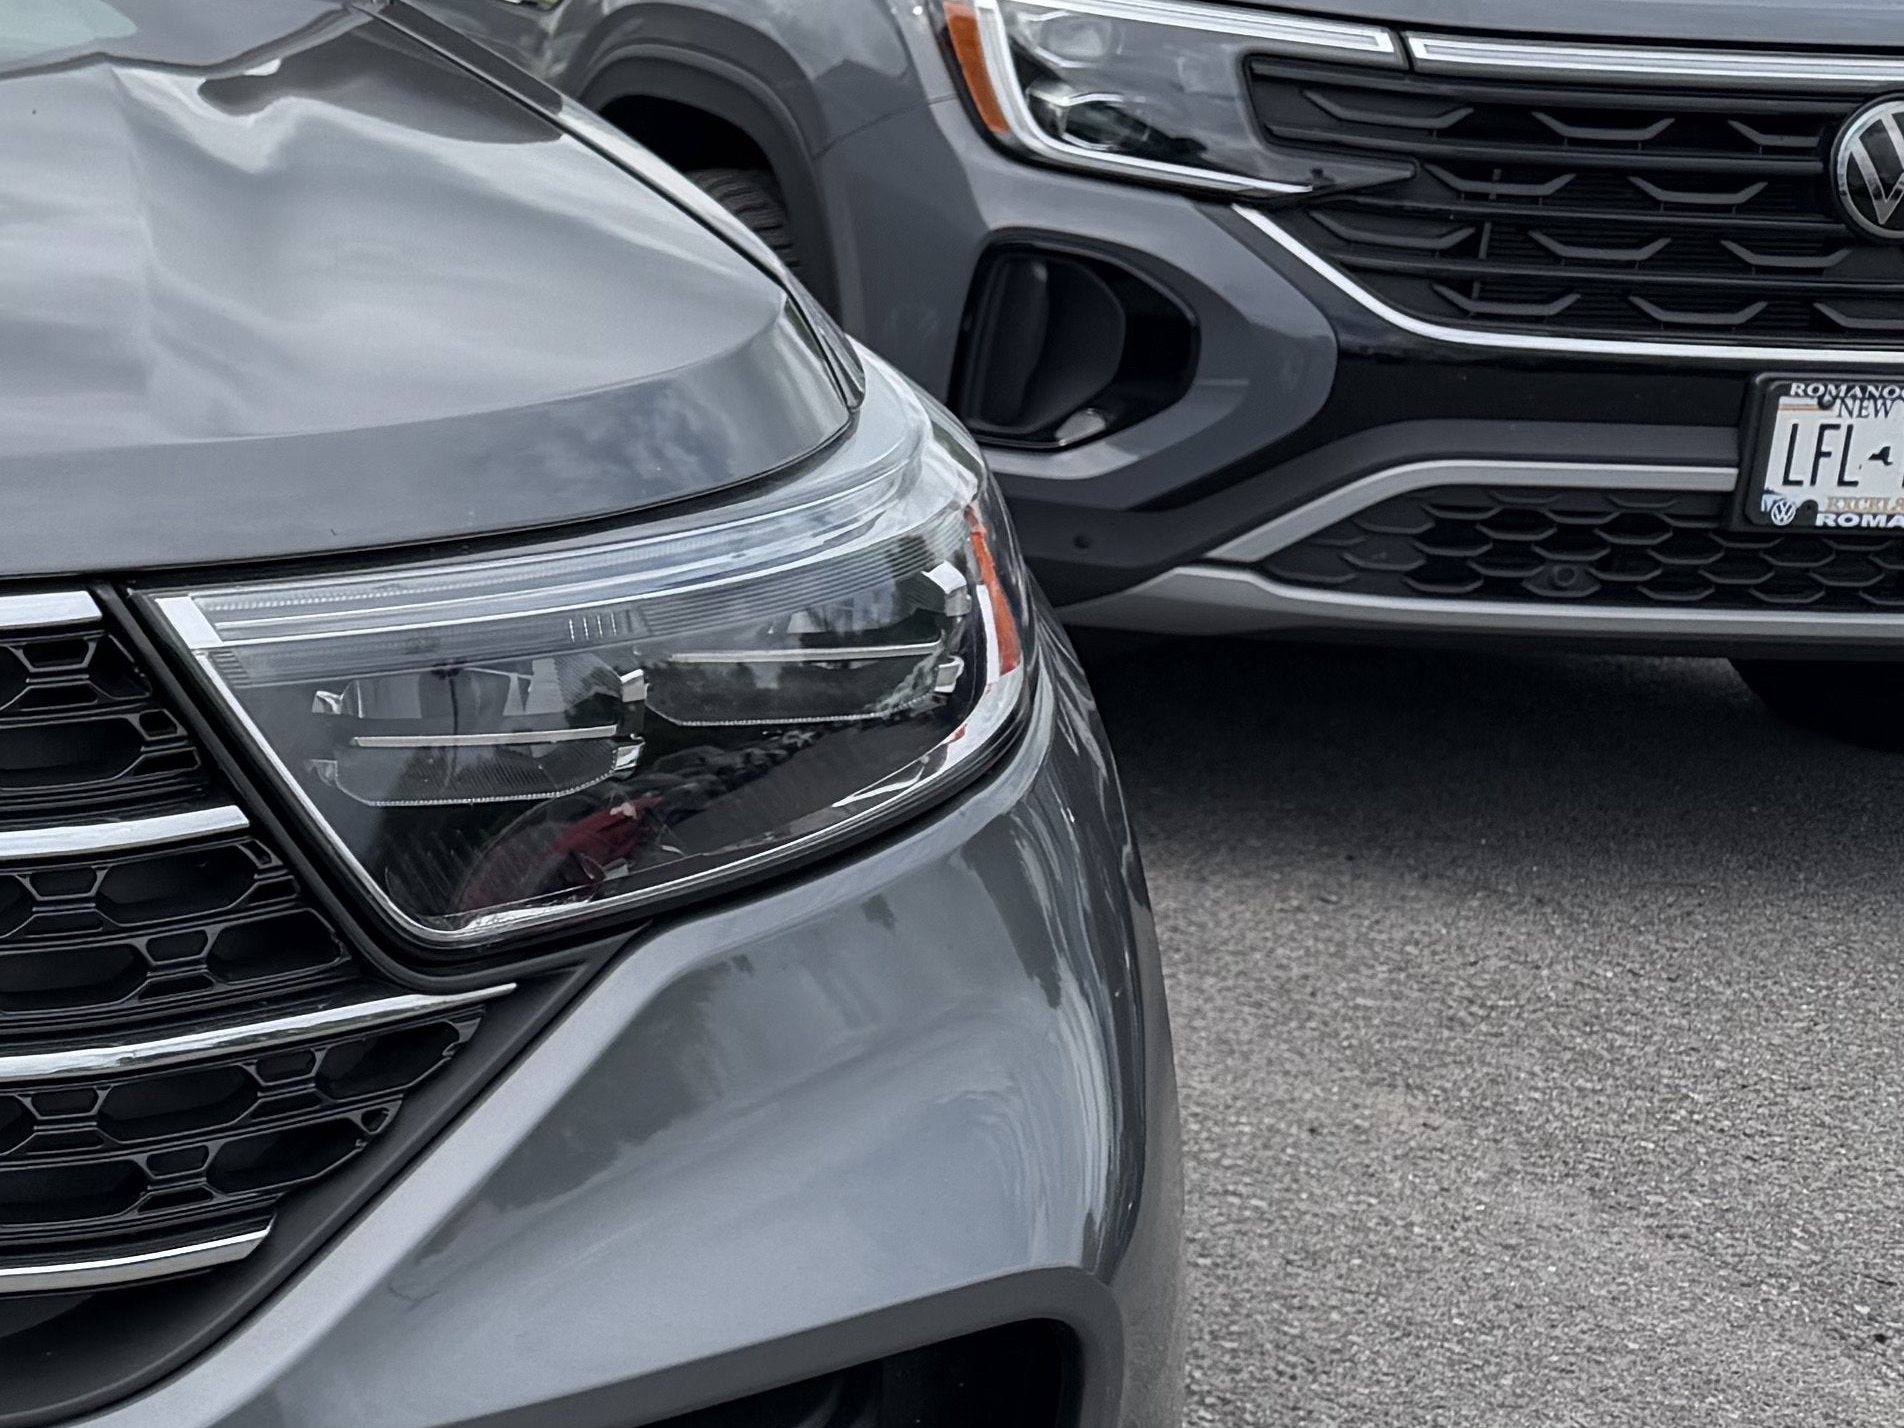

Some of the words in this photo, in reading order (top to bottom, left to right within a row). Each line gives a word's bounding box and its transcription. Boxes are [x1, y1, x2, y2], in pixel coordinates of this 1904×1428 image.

[1790, 382, 1904, 399] ROMANO
[1836, 398, 1893, 419] NEW
[1781, 423, 1860, 487] LFL
